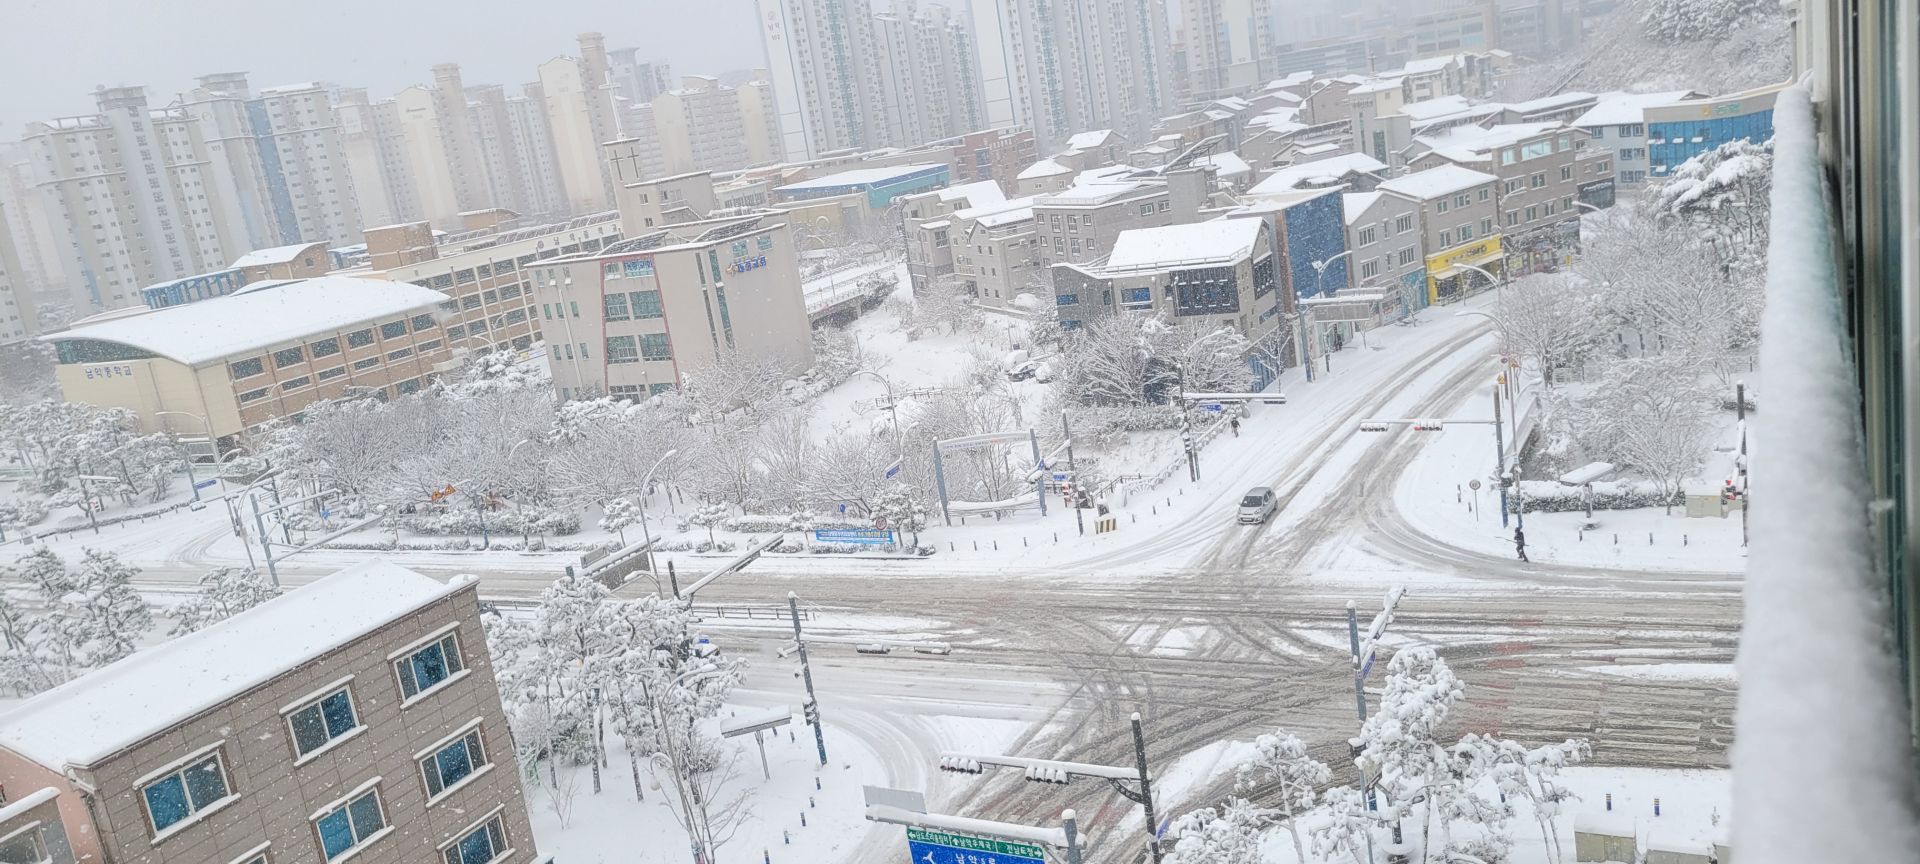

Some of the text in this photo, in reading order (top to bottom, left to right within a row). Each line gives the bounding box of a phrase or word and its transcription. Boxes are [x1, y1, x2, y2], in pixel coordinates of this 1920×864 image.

[85, 365, 133, 380] 남악중학교
[959, 838, 992, 851] 남악우체국
[1005, 843, 1035, 857] 전남도청
